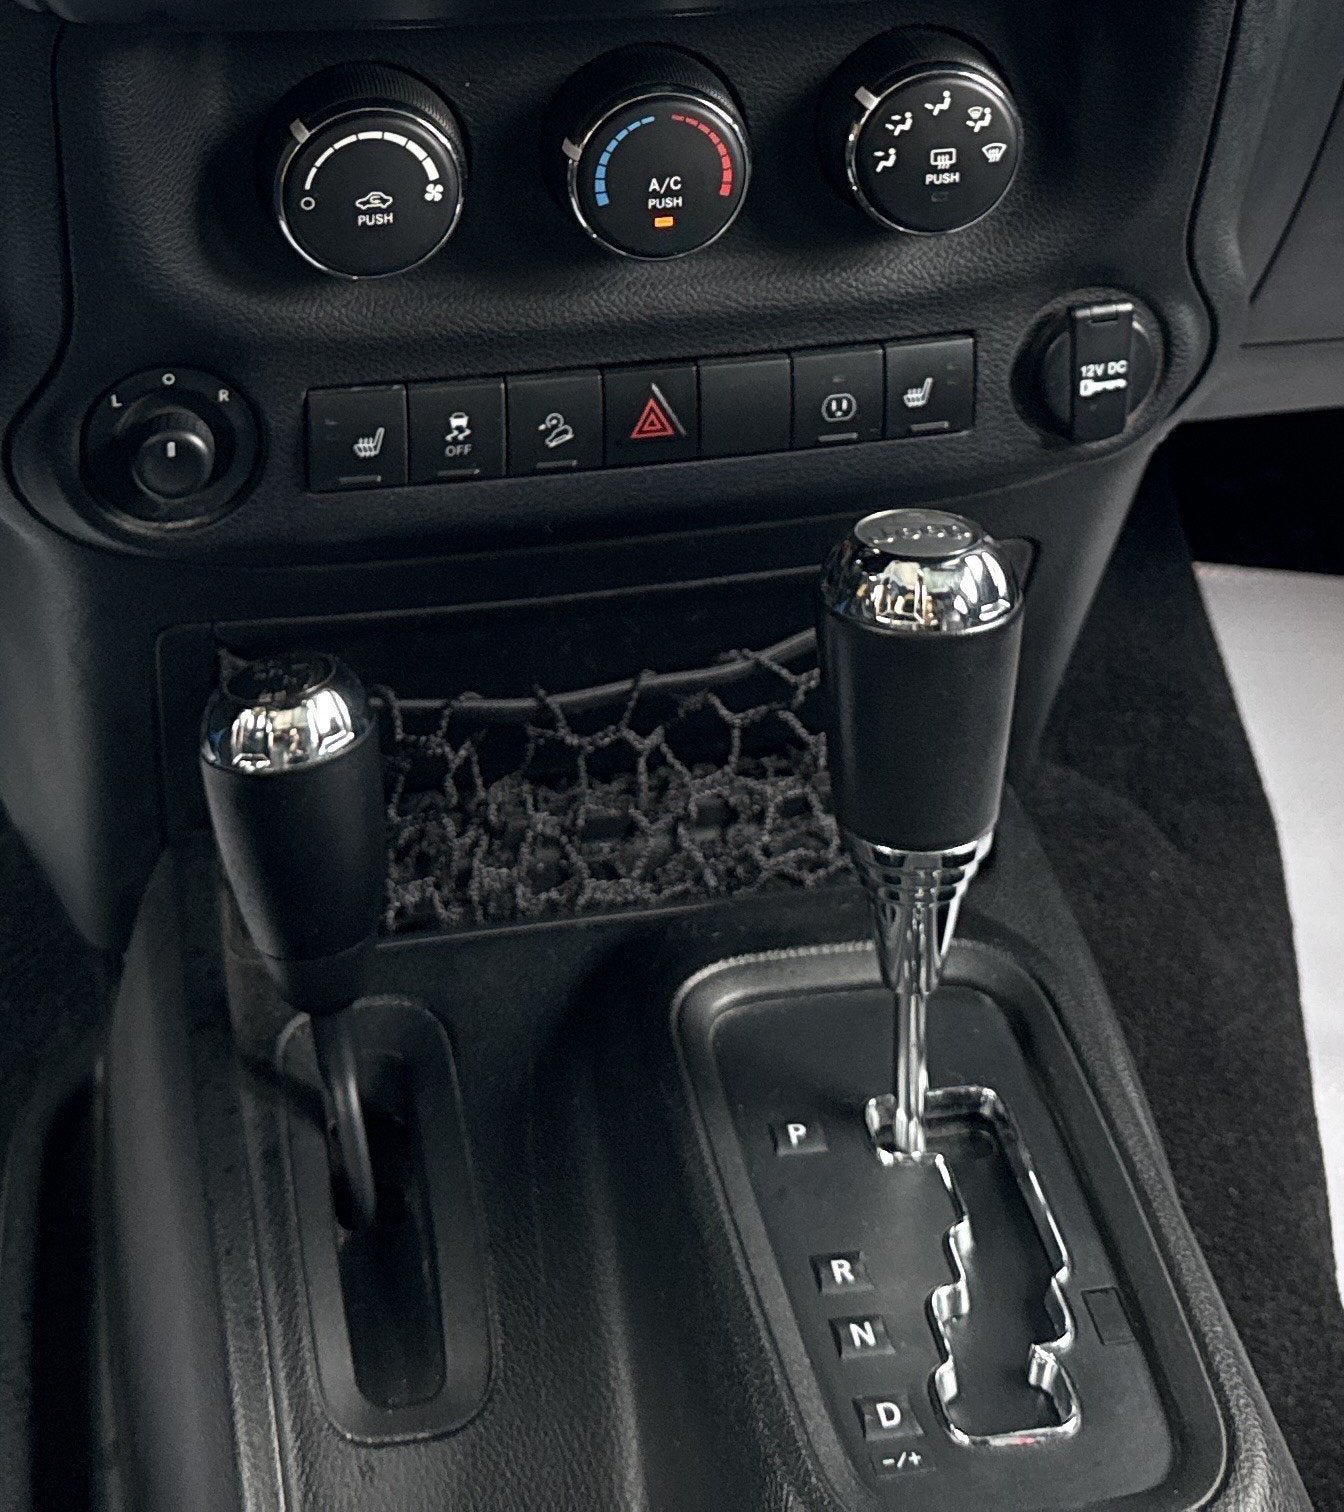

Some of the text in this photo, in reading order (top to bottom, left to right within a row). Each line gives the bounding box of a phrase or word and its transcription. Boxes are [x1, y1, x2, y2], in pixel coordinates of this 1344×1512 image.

[648, 175, 682, 194] A/C
[925, 172, 961, 186] PUSH
[647, 196, 683, 210] PUSH
[357, 212, 394, 227] PUSH
[1080, 359, 1128, 377] 12V DC
[111, 394, 123, 408] L
[218, 389, 230, 403] R
[445, 444, 473, 457] OFF
[787, 1123, 808, 1146] P
[830, 1259, 855, 1283] R
[849, 1322, 876, 1348] N
[876, 1402, 902, 1429] D
